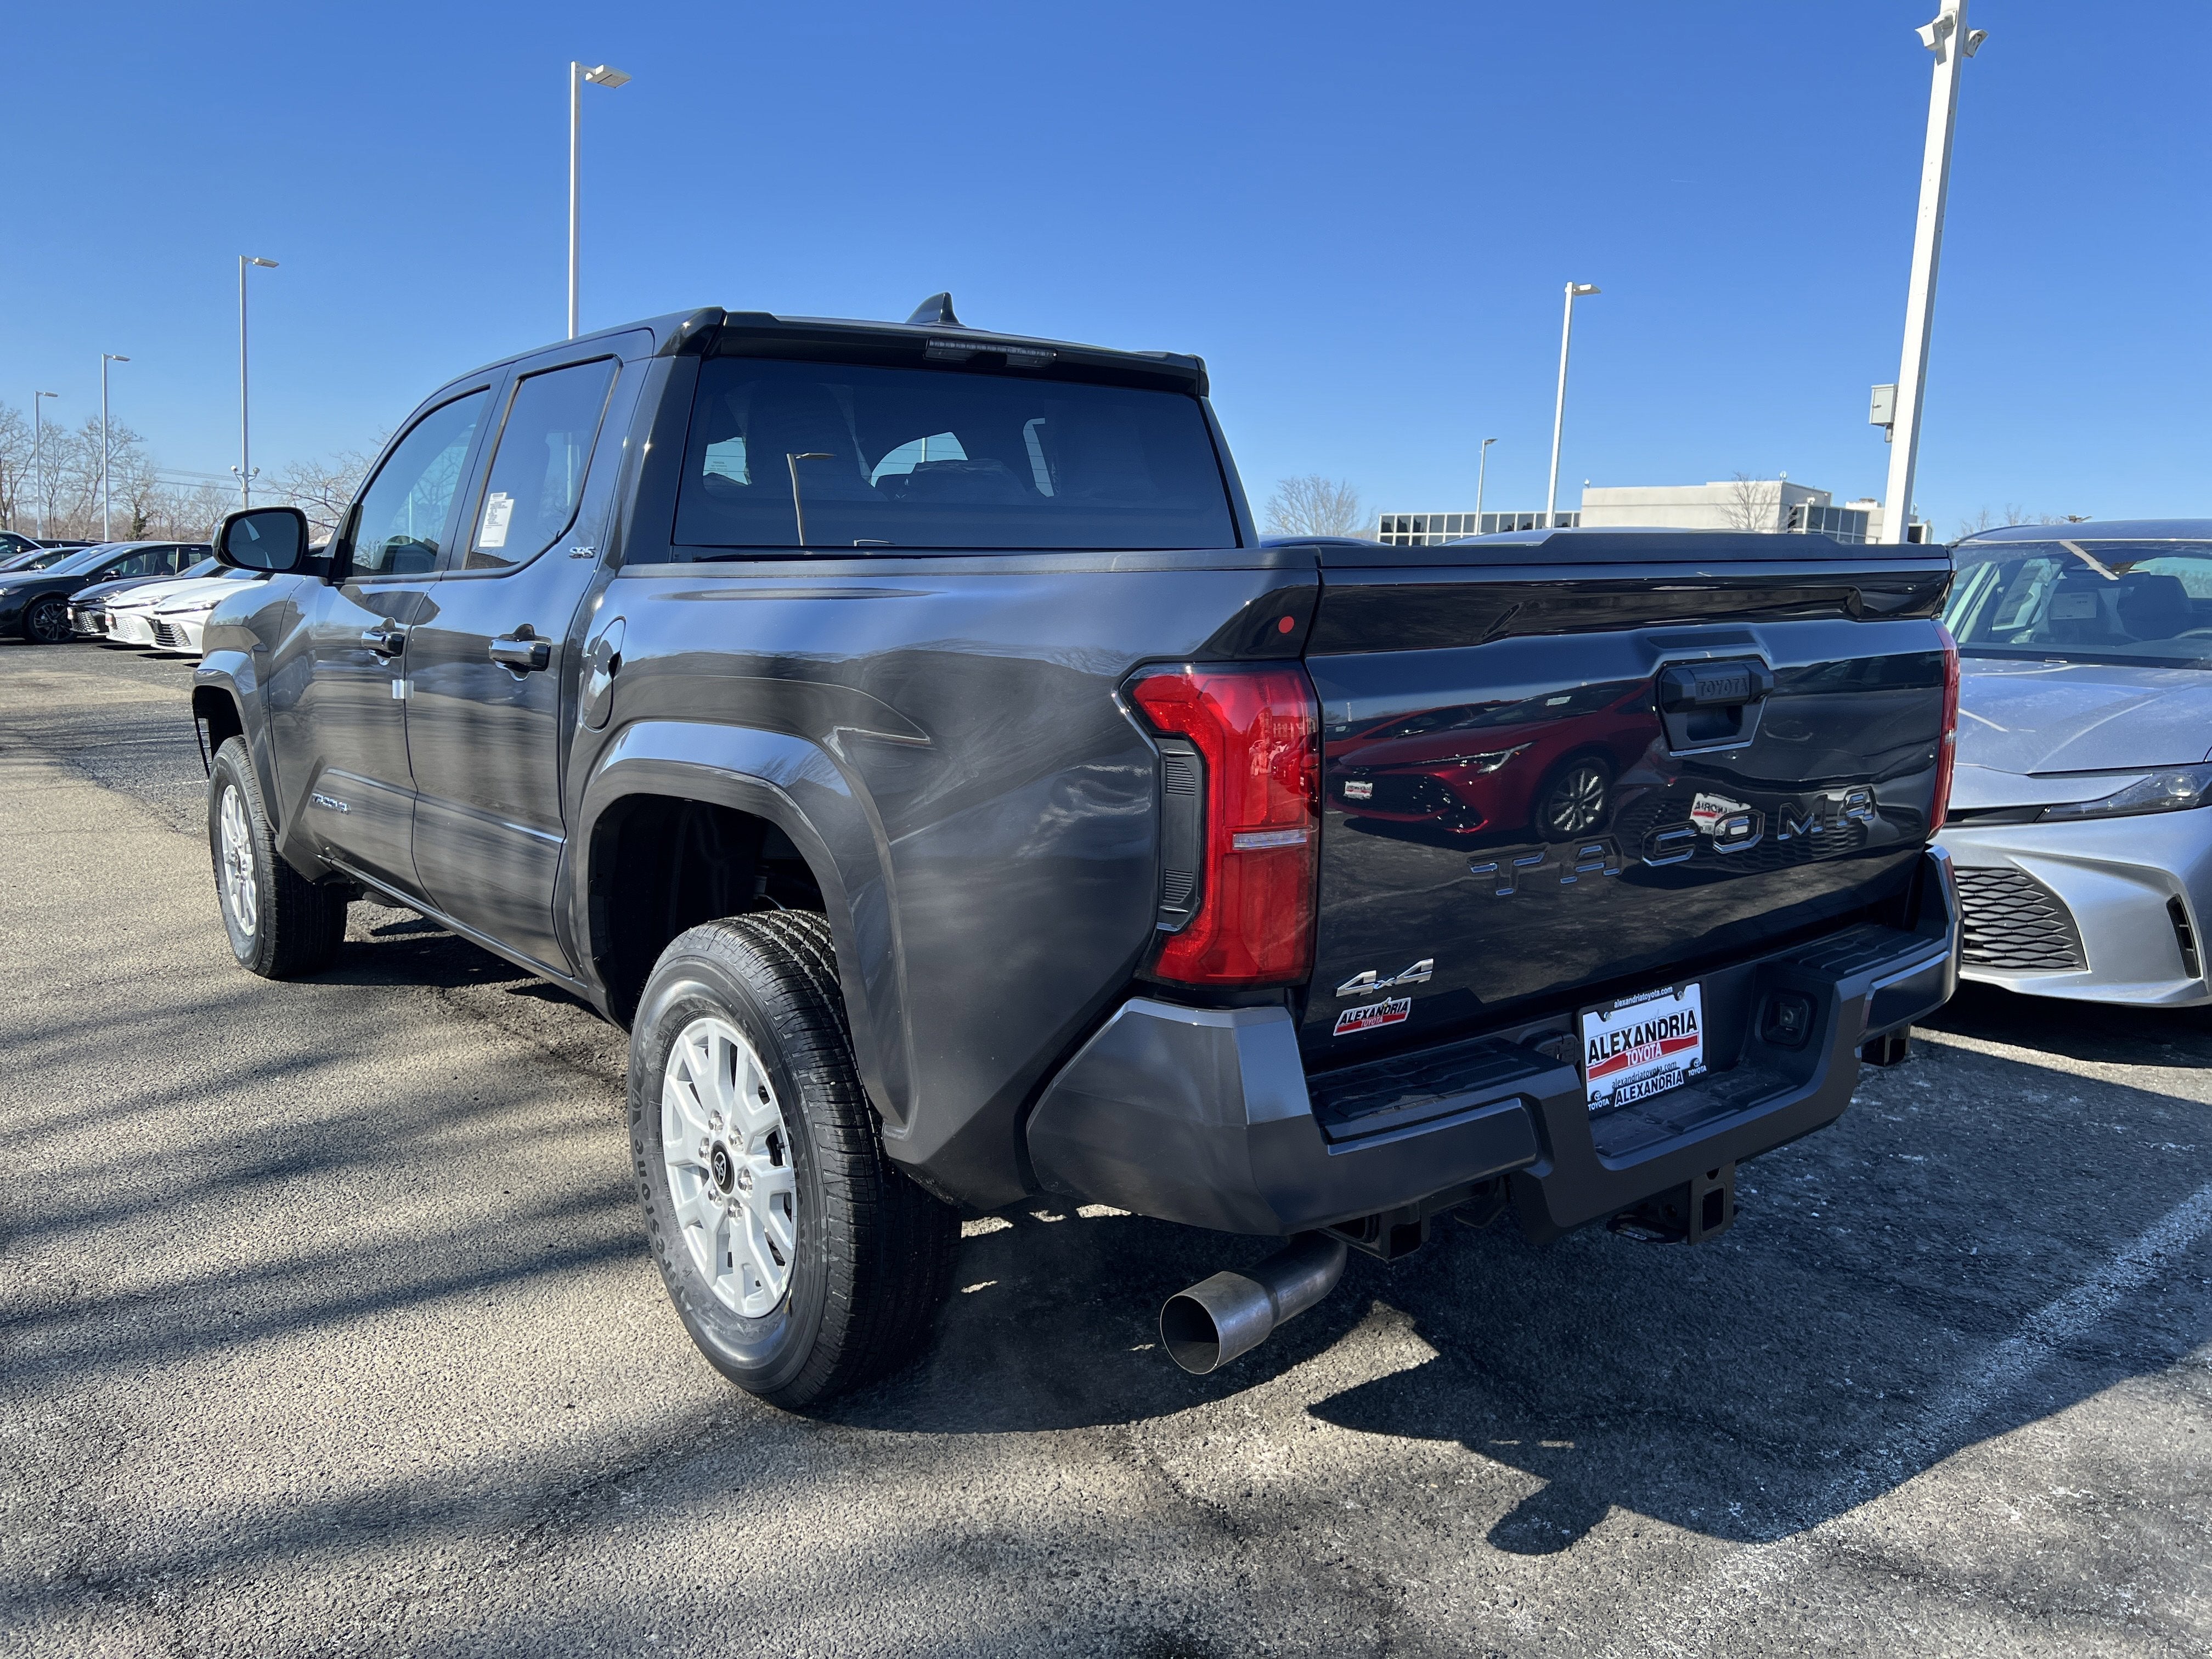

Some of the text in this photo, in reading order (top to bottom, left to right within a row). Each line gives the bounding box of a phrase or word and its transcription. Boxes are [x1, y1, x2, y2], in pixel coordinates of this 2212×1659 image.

[1698, 678, 1749, 696] TOYOTA
[1467, 786, 1876, 896] TACOMA
[1614, 986, 1673, 1008] alexandriatoyota.com
[1339, 1001, 1408, 1025] ALEXANDRIA
[1361, 1016, 1383, 1028] TOYOTA
[1587, 1009, 1698, 1064] ALEXANDRIA
[1626, 1042, 1663, 1066] TOYOTA
[1688, 1065, 1707, 1077] TOYOTA
[1614, 1070, 1684, 1107] ALEXANDRIA
[1588, 1098, 1610, 1111] TOYOTA
[634, 1138, 683, 1299] Firestone
